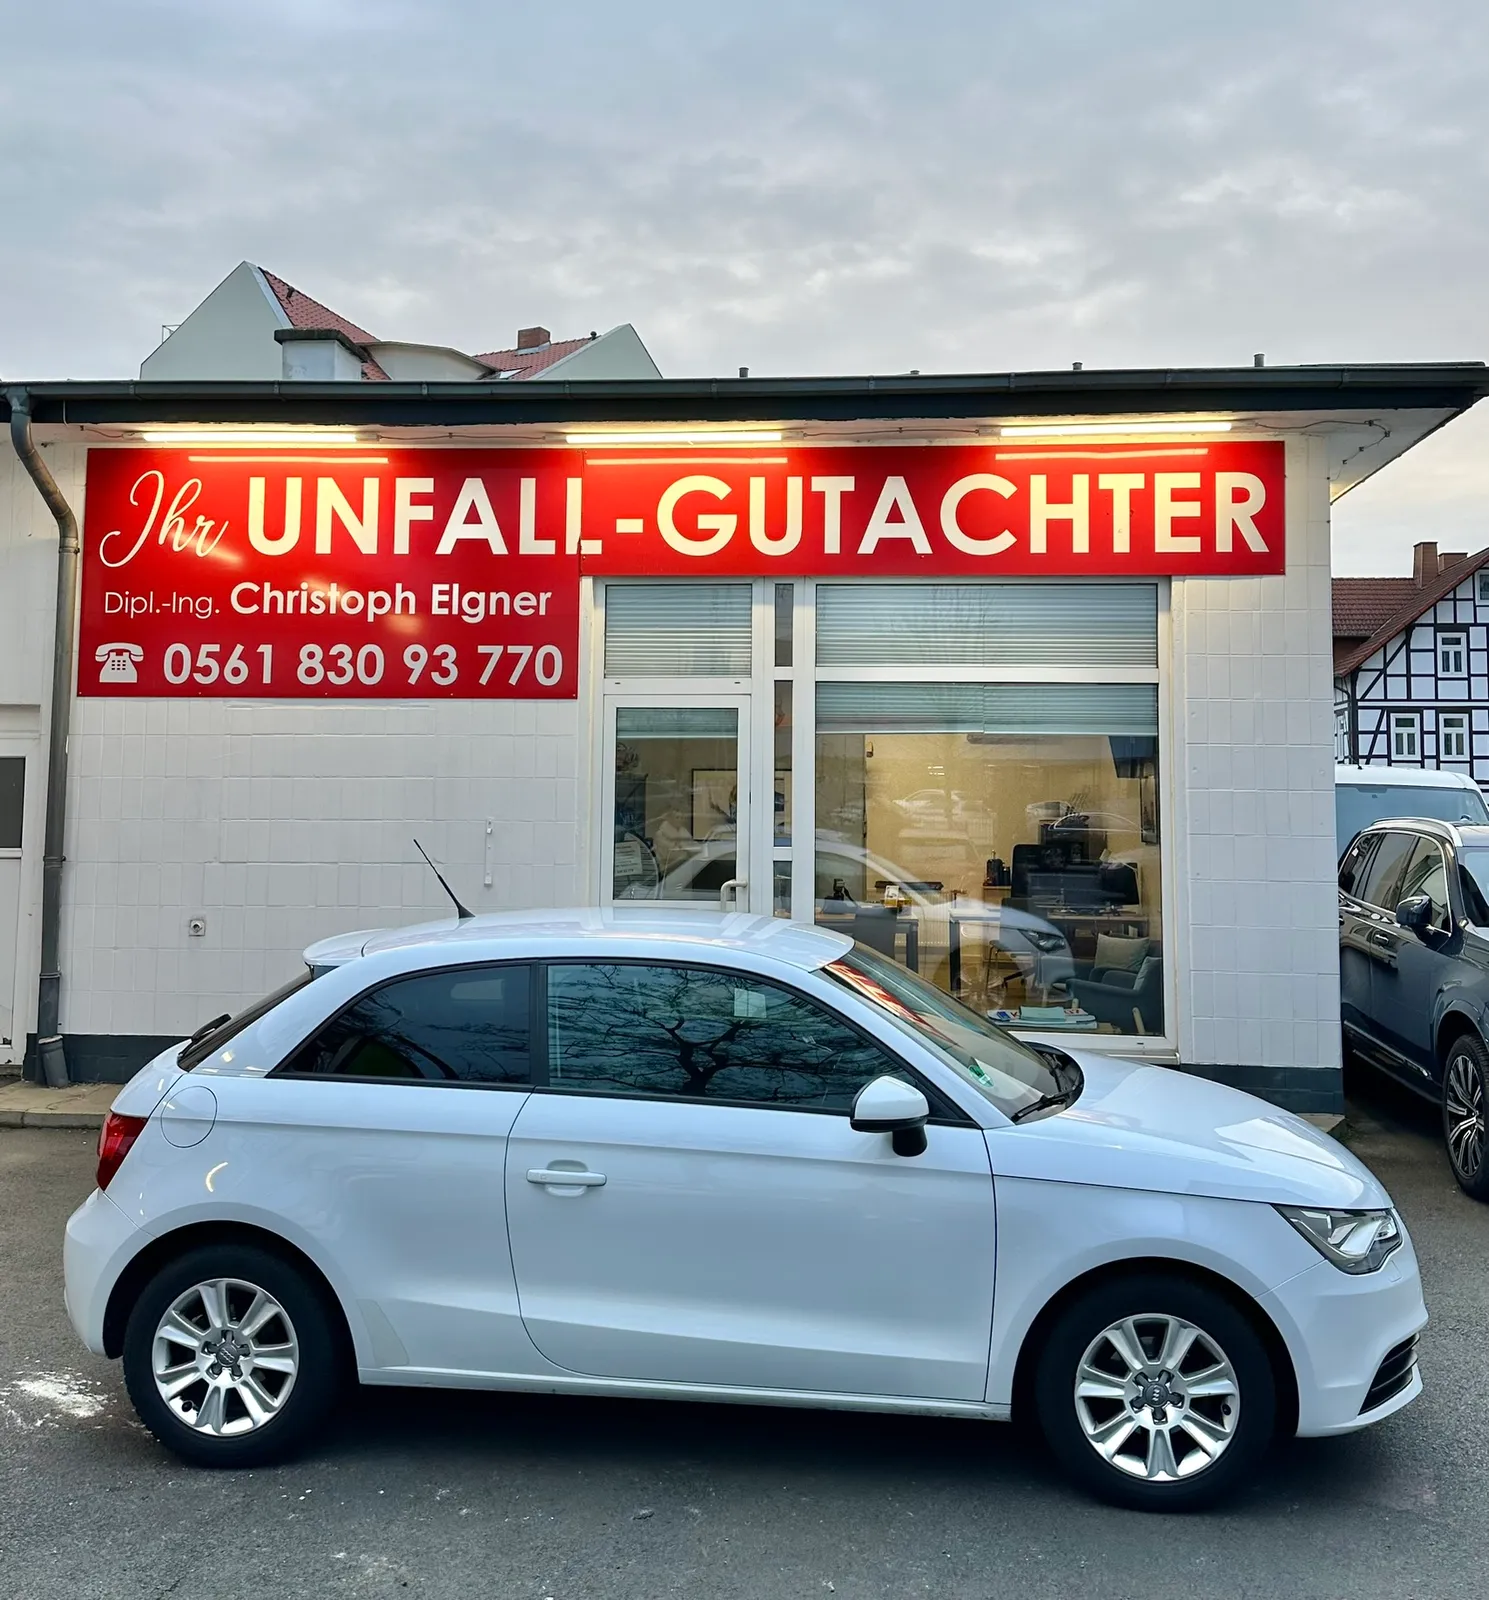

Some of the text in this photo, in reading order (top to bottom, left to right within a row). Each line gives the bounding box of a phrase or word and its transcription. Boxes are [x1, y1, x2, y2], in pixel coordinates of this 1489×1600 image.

[99, 469, 230, 568] Ihr
[104, 580, 553, 625] Dipl.-Ing. Christoph Elgner
[163, 642, 563, 687] 0561 830 93 770
